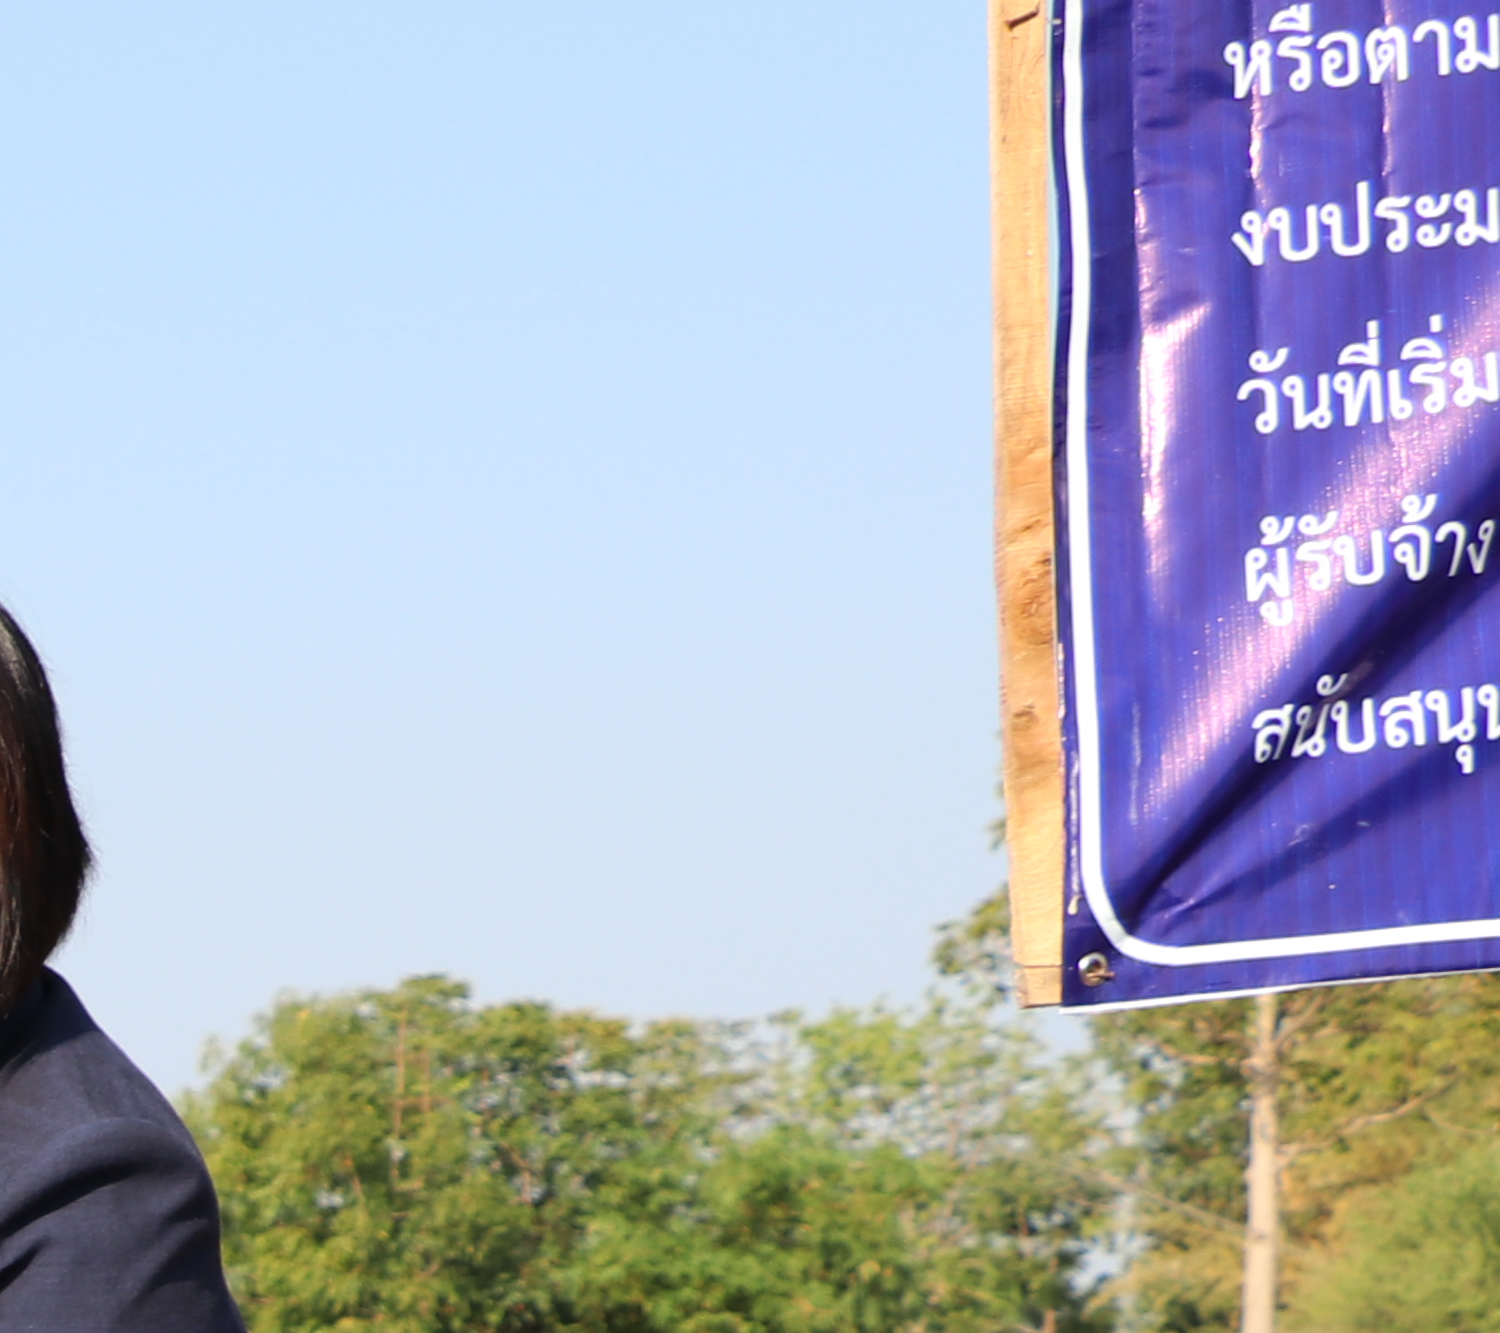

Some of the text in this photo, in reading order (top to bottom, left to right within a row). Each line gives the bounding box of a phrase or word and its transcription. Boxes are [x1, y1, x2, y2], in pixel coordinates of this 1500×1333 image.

[1223, 2, 1500, 100] หรือตาม
[1231, 180, 1500, 267] งบประม
[1236, 314, 1500, 435] วันที่เริ่ม
[1244, 492, 1497, 627] ผู้รับจ้าง
